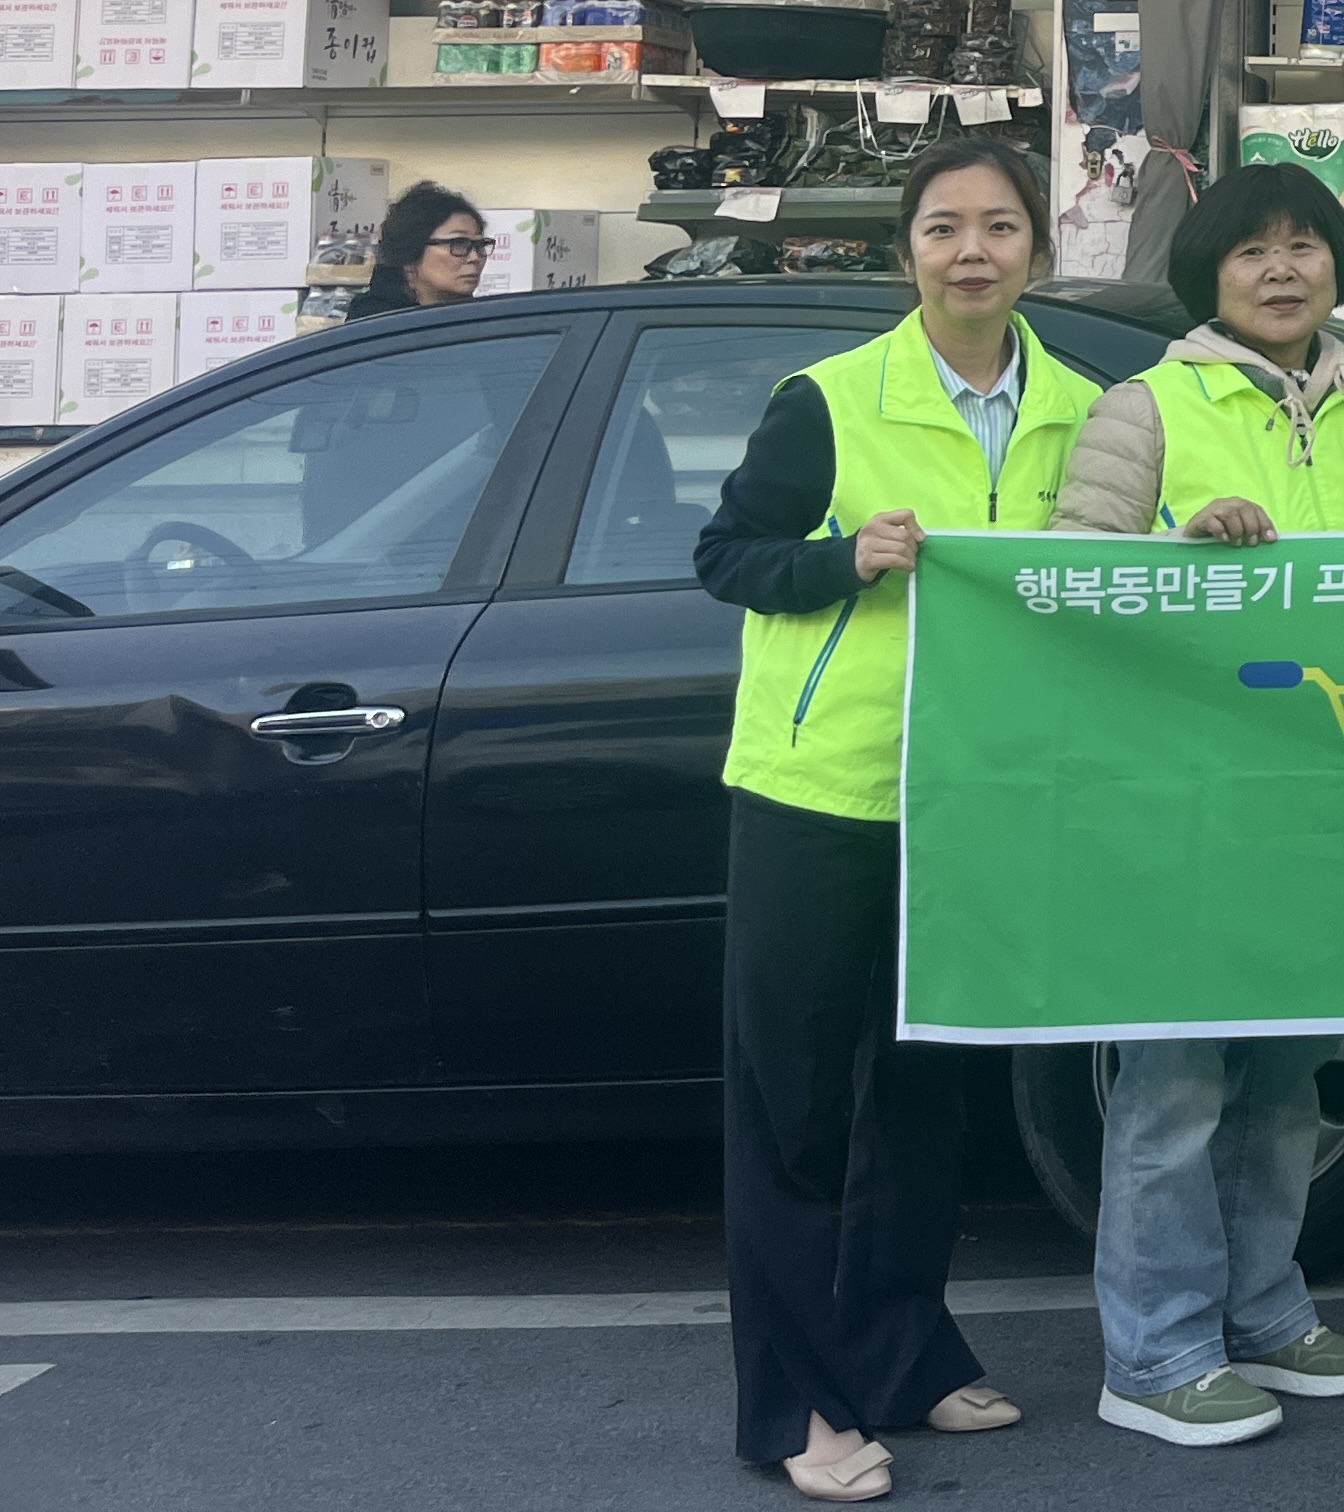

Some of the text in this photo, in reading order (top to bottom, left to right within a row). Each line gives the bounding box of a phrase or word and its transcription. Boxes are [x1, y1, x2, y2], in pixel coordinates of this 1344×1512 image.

[323, 27, 377, 64] 종이컵
[1288, 128, 1341, 150] Hello
[1014, 560, 1293, 616] 행복동만들기
